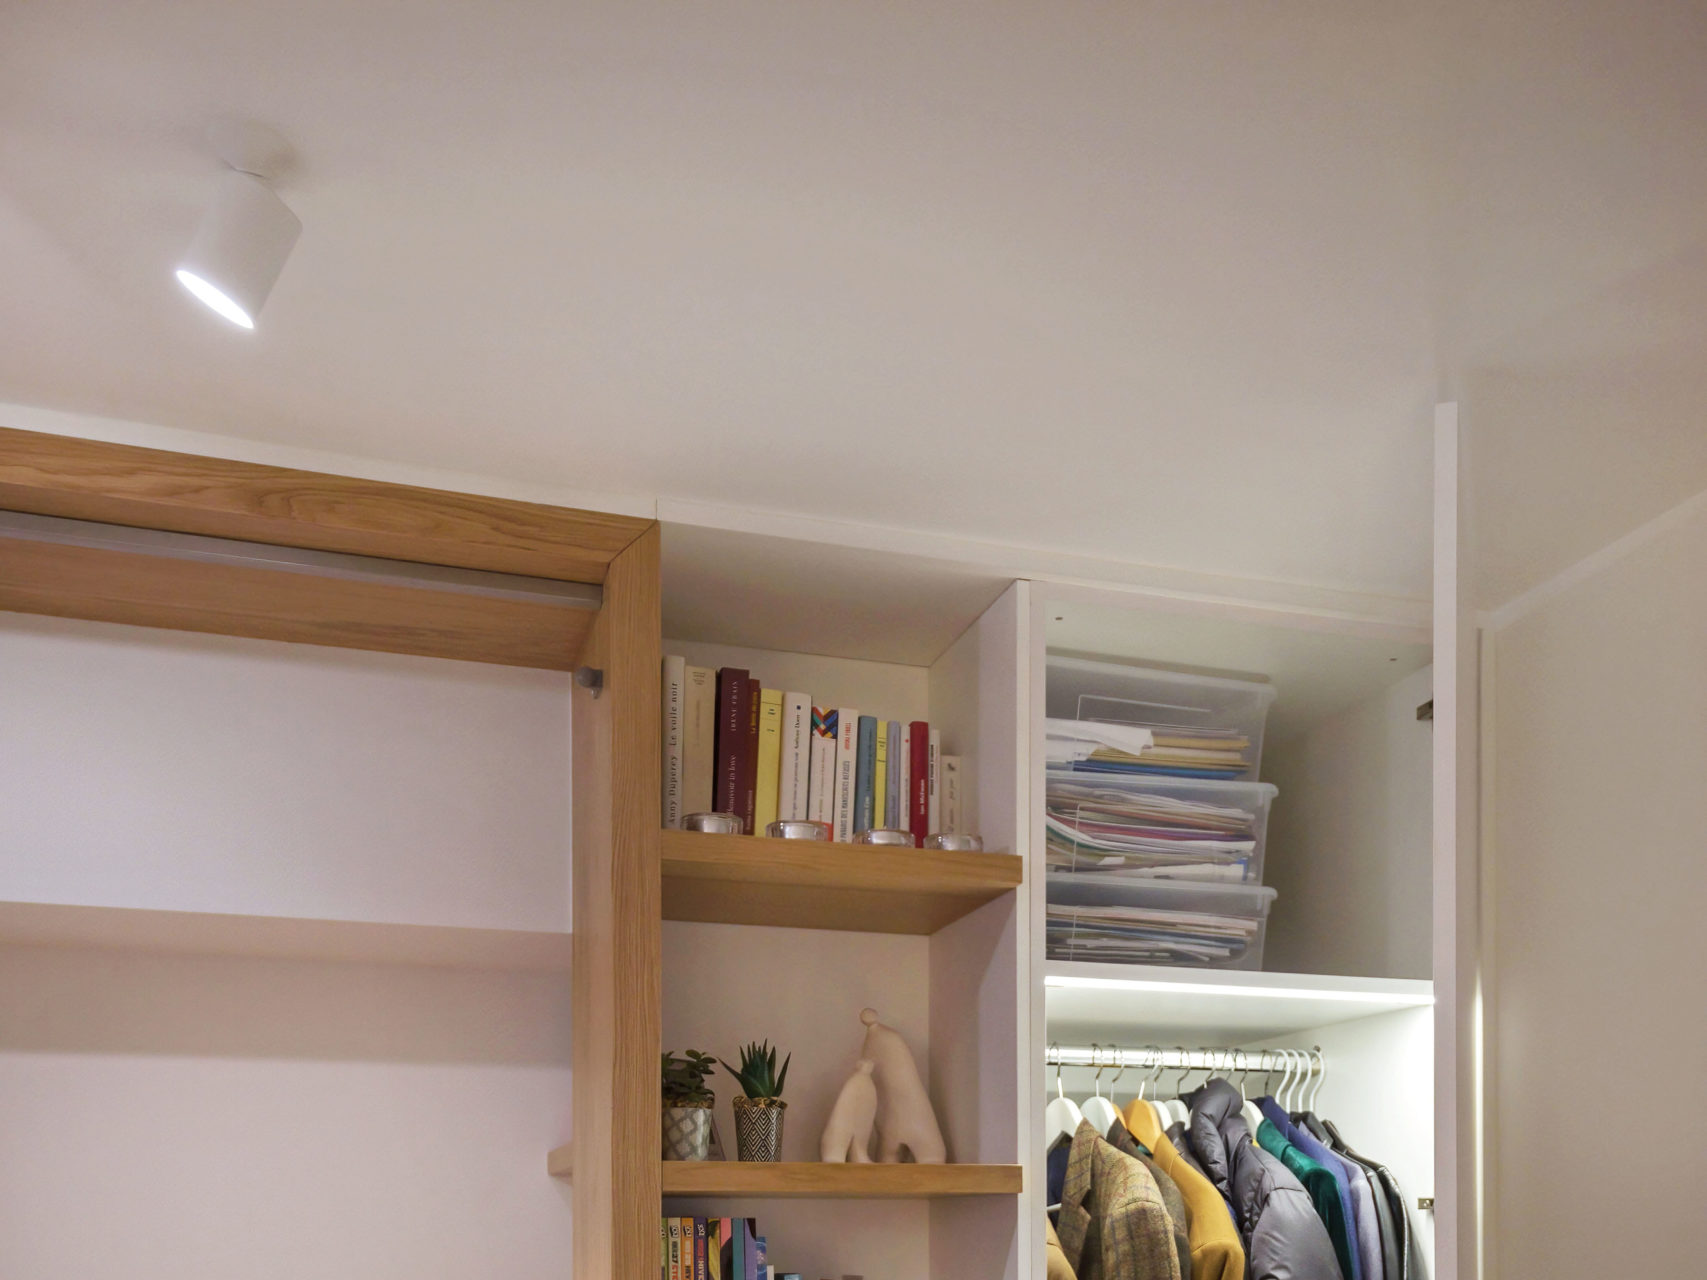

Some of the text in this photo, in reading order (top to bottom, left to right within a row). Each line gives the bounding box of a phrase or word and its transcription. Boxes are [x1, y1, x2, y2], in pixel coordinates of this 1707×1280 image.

[668, 682, 678, 823] Anny Duperey Le voile noir
